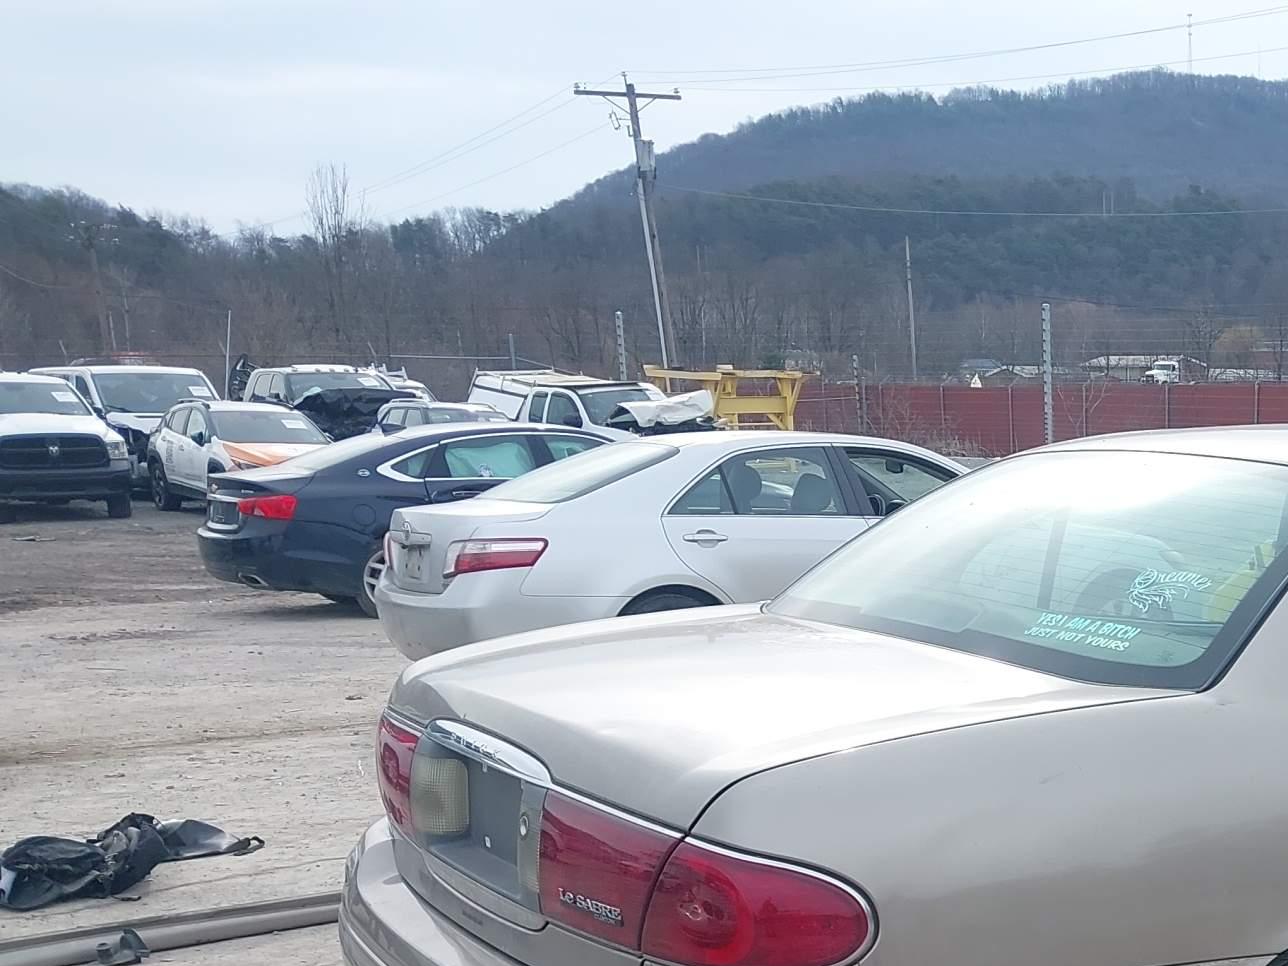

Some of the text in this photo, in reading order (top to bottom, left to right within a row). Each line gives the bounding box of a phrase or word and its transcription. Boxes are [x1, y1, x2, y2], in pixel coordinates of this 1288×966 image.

[1136, 568, 1212, 591] Dreamer
[1024, 627, 1130, 651] JUST NOT YOURS
[1064, 617, 1091, 630] AM
[1085, 620, 1102, 633] A
[1098, 622, 1141, 640] BITCH
